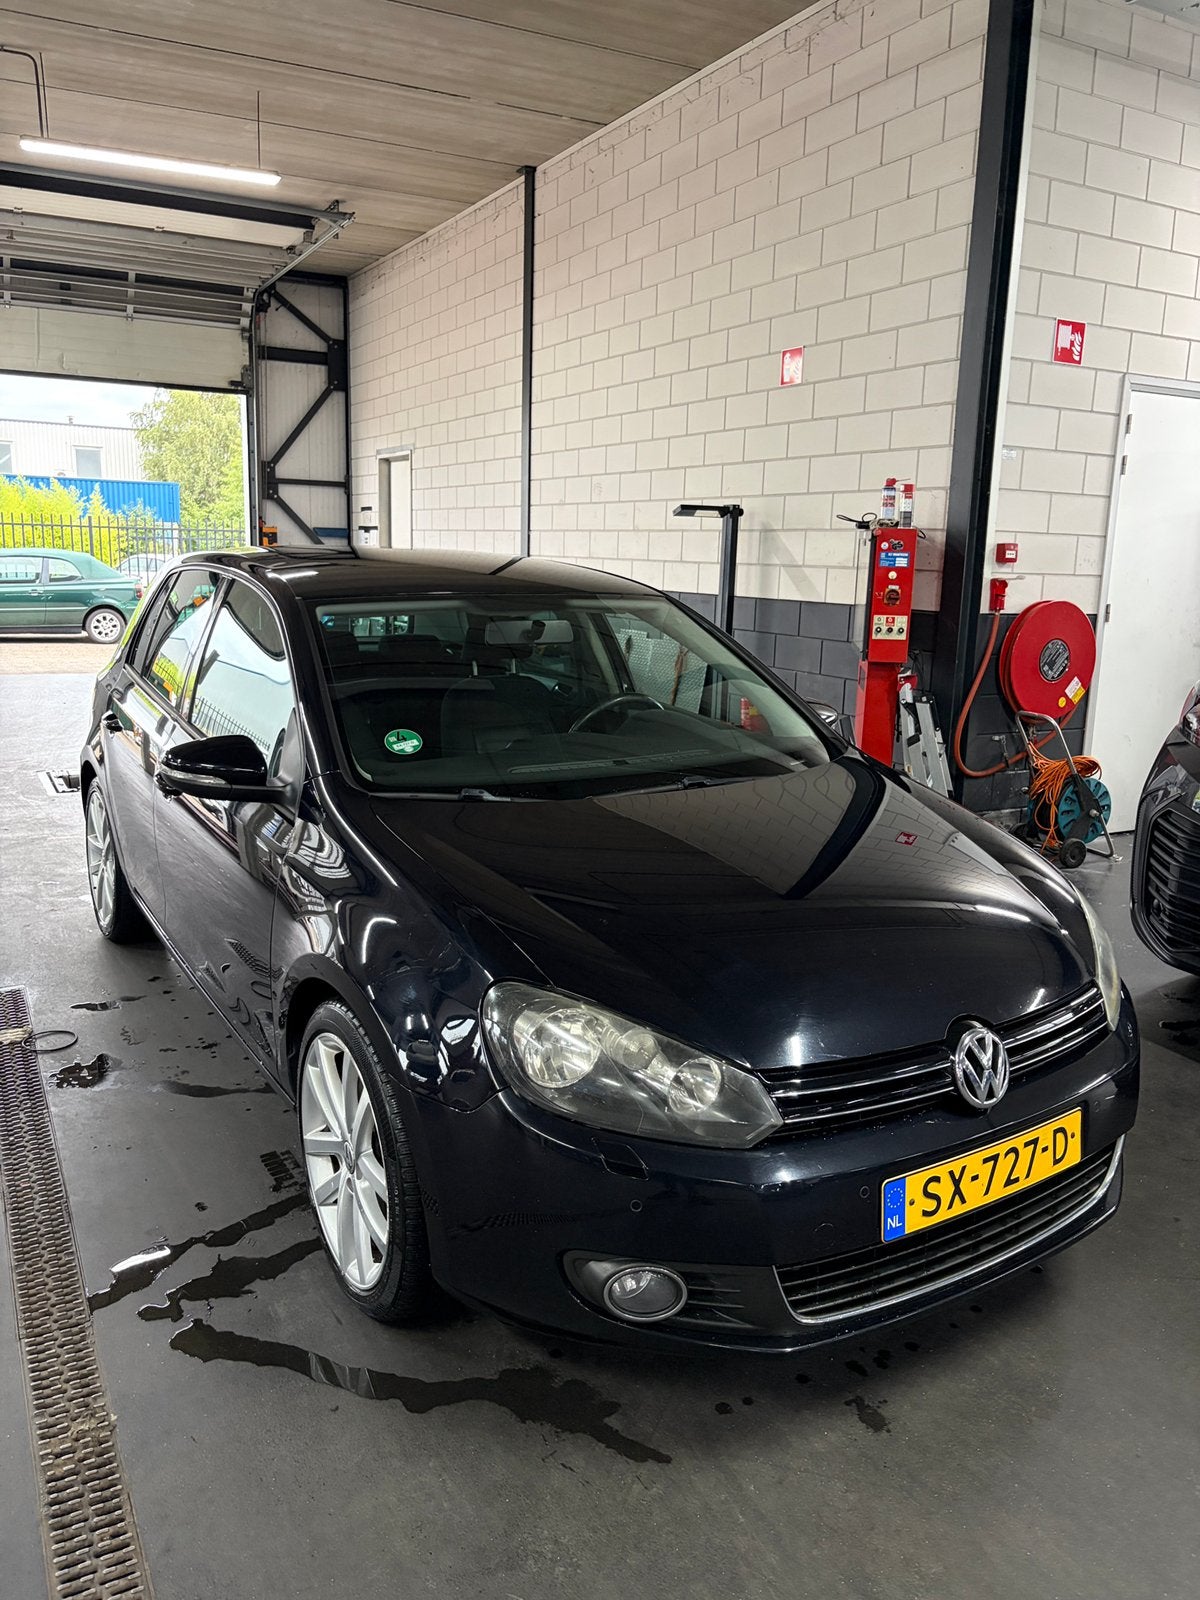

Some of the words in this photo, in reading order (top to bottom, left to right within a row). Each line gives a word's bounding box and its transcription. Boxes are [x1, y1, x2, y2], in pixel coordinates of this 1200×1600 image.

[959, 1030, 1007, 1105] VW
[921, 1126, 1069, 1218] SX-727-D
[887, 1214, 902, 1231] NL
